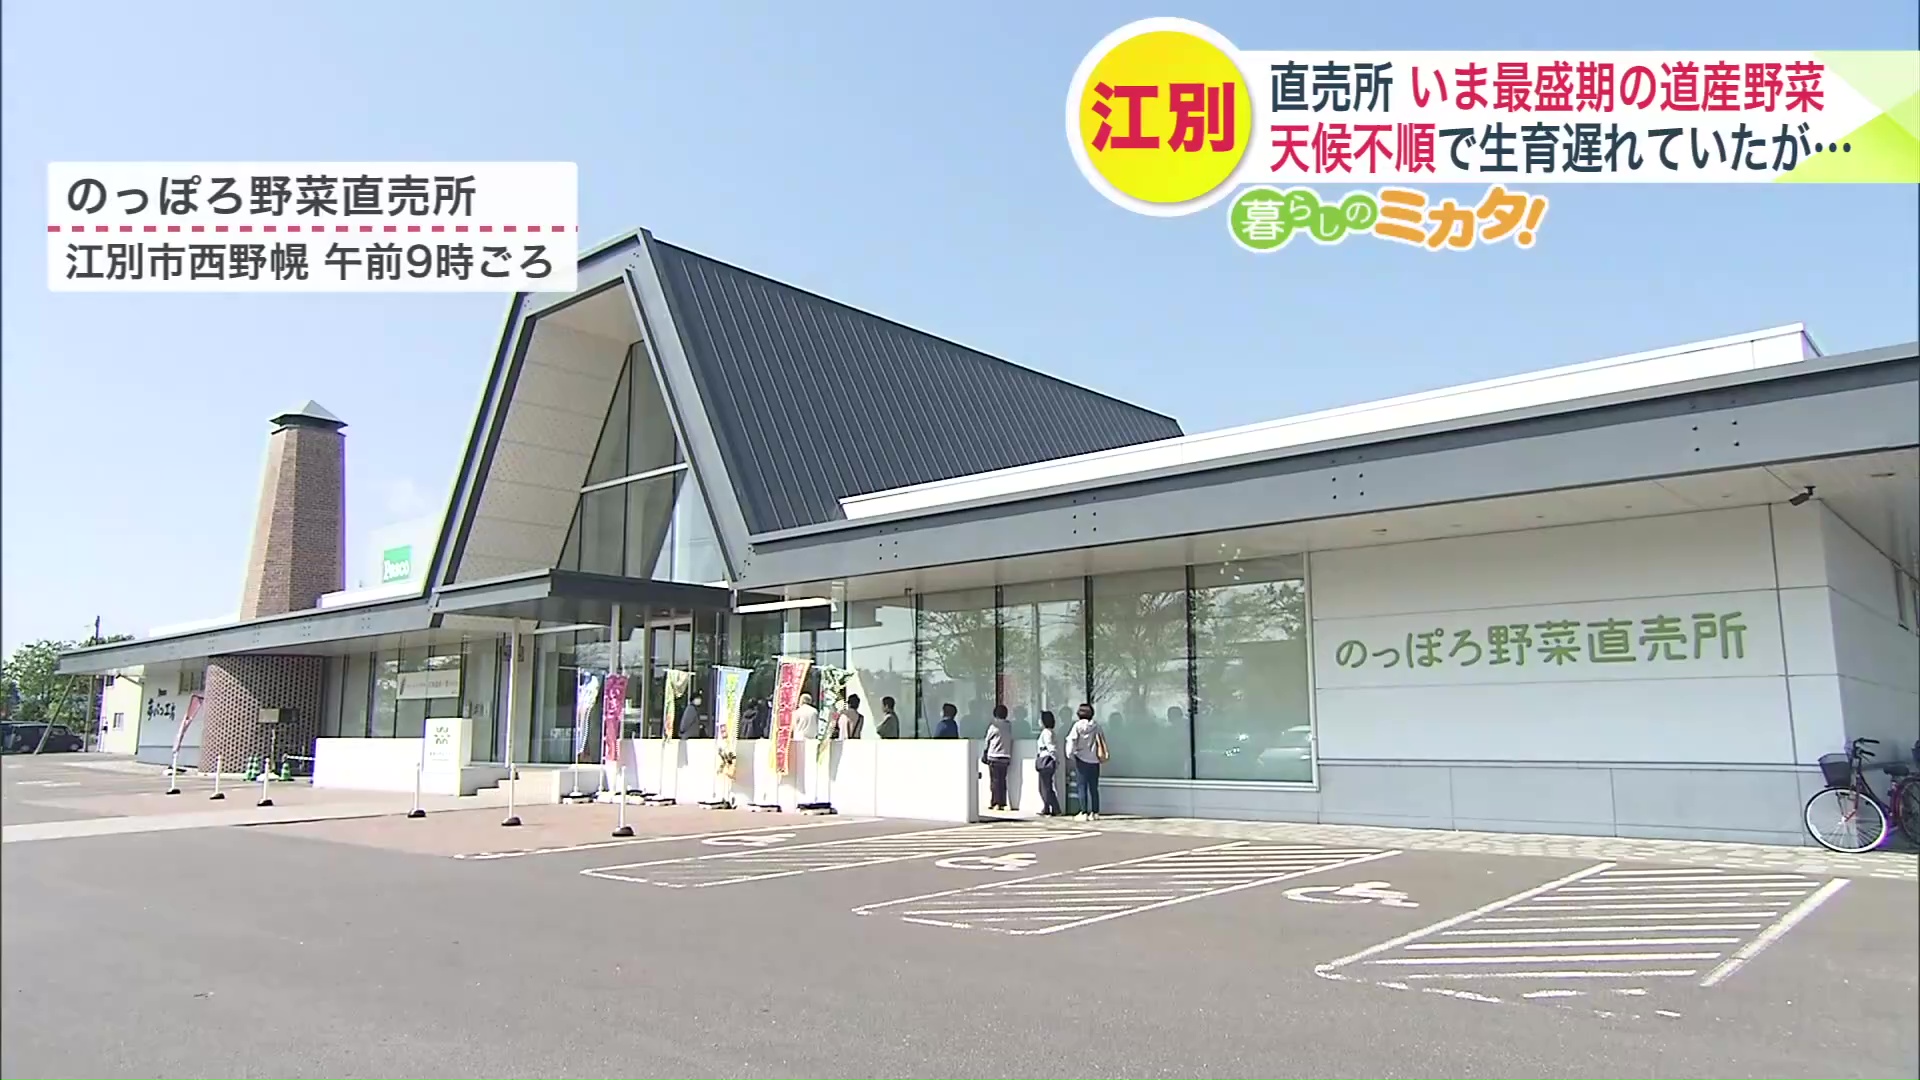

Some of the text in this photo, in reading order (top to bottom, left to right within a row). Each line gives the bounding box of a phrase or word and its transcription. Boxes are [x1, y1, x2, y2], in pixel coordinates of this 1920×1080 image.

[1335, 611, 1747, 669] のっぽろ野菜直売所
